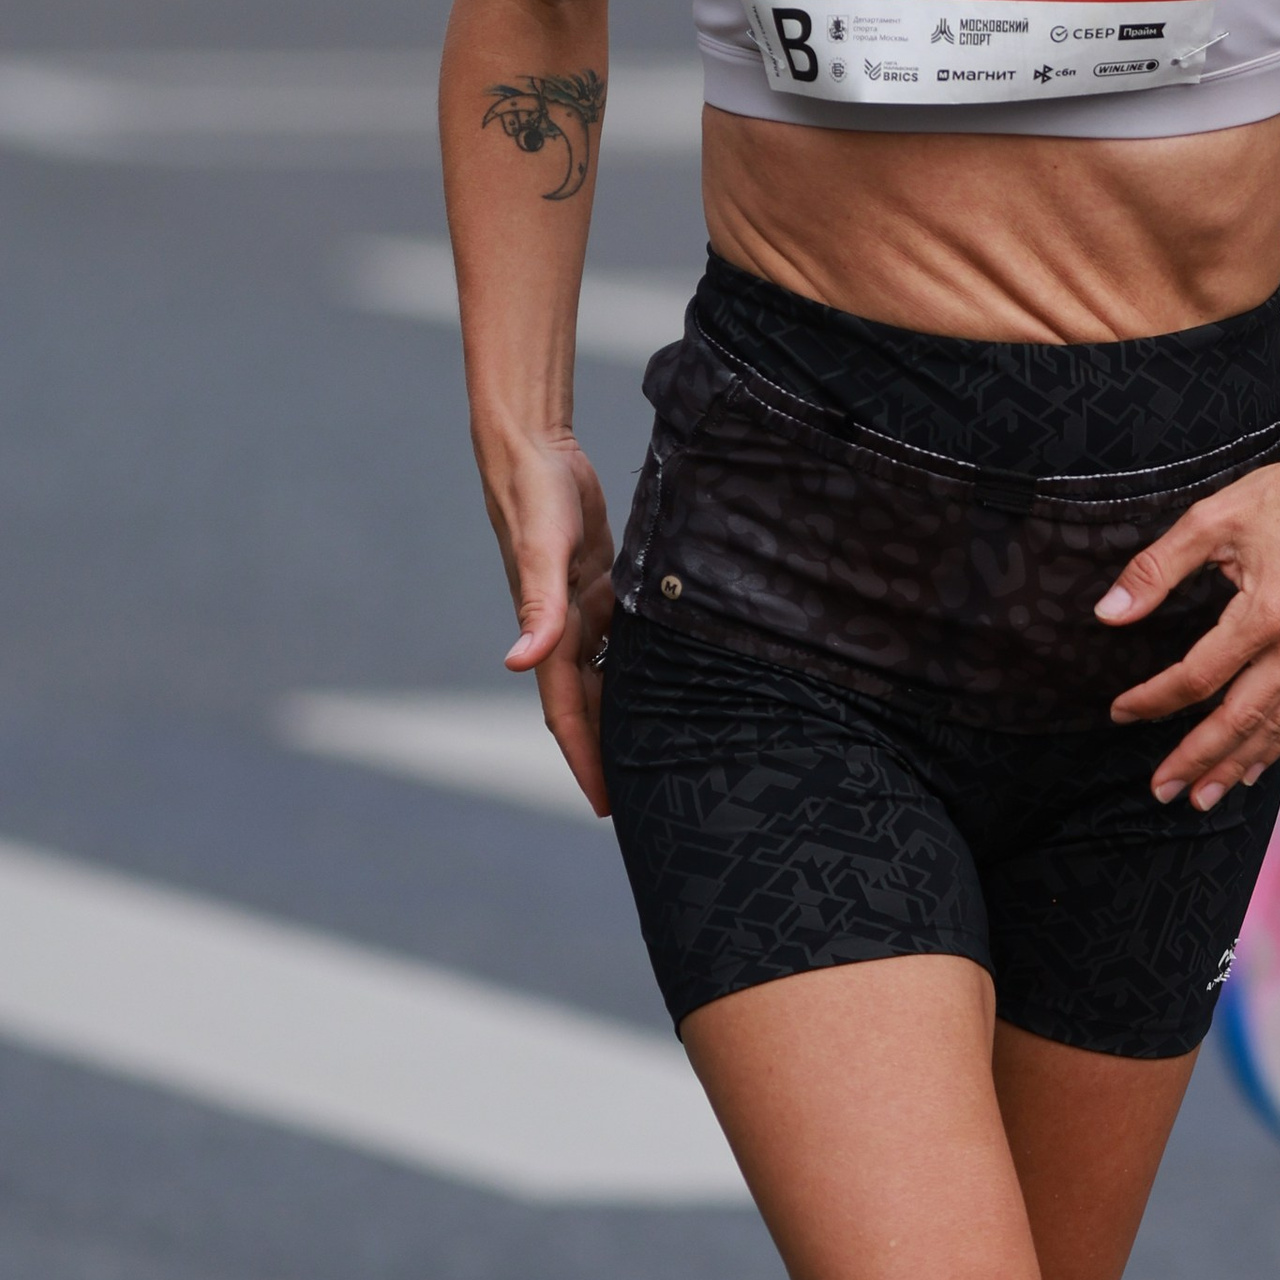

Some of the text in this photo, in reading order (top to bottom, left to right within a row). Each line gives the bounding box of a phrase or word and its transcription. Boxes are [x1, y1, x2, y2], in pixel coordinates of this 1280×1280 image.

[960, 17, 1029, 33] МОСКОВСКИЙ
[959, 33, 992, 46] СПОРТ
[1072, 26, 1158, 40] СБЕР Прайм
[1098, 62, 1145, 74] WINLINE
[883, 72, 919, 82] BRICS
